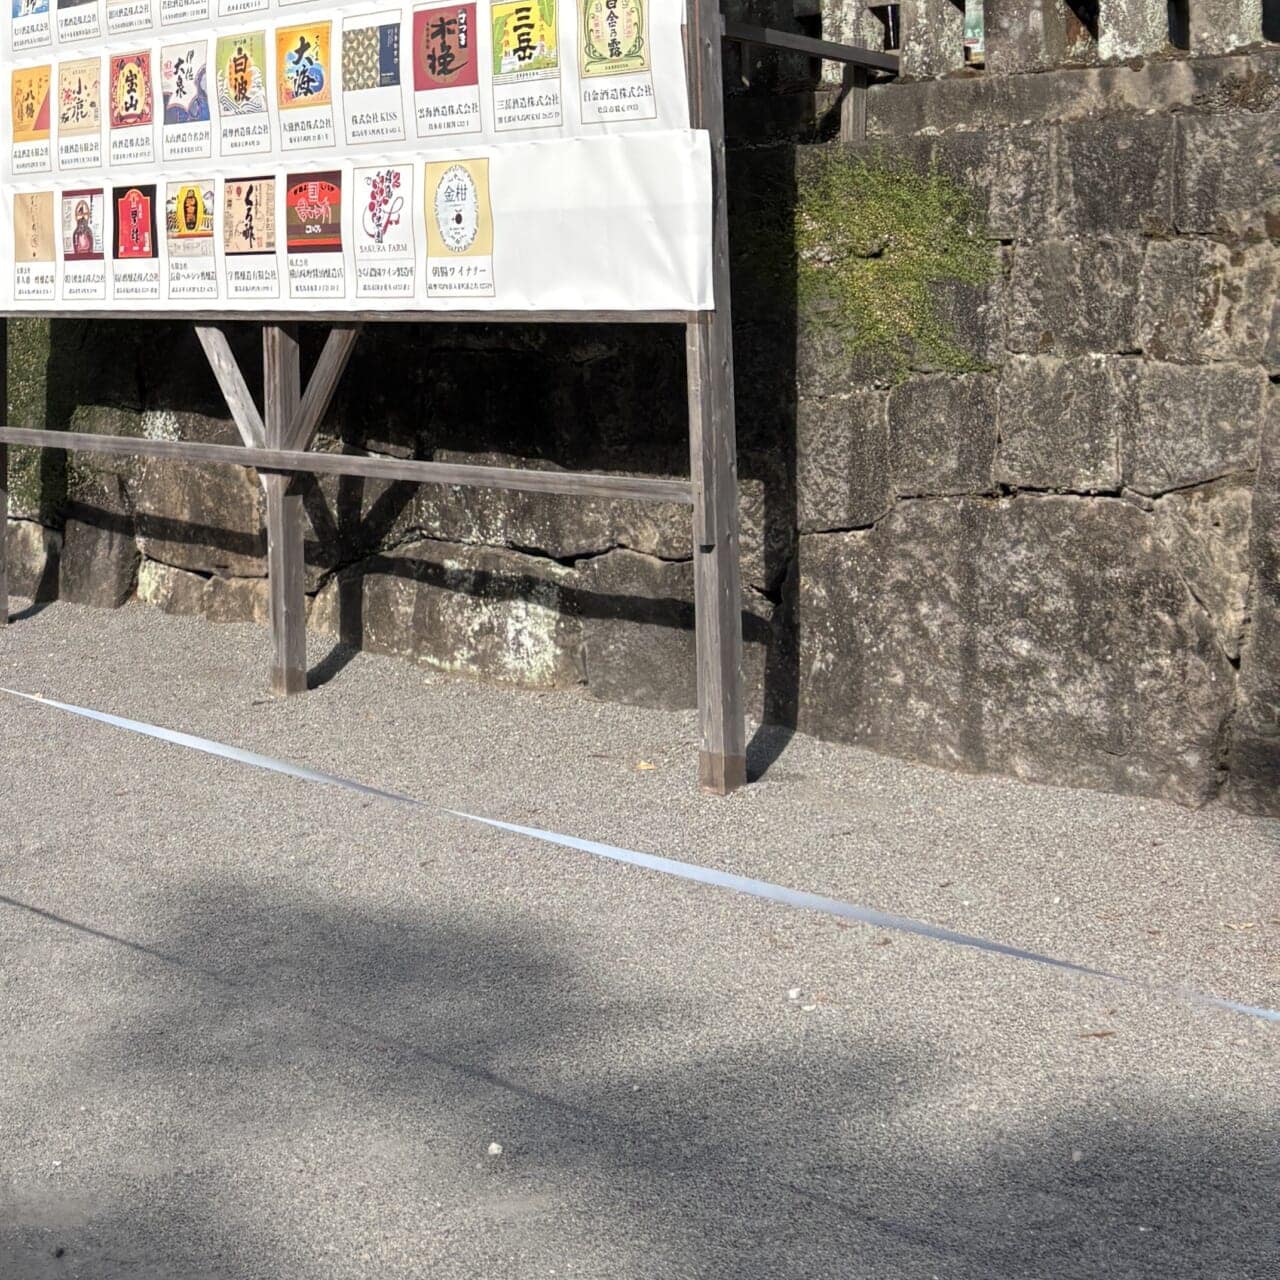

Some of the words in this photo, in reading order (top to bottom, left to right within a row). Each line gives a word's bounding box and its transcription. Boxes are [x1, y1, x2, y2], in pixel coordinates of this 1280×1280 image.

[513, 7, 537, 62] 三岳
[124, 70, 138, 112] 宝山
[233, 47, 251, 103] 白波
[293, 35, 314, 96] 大海
[444, 185, 468, 203] 金柑
